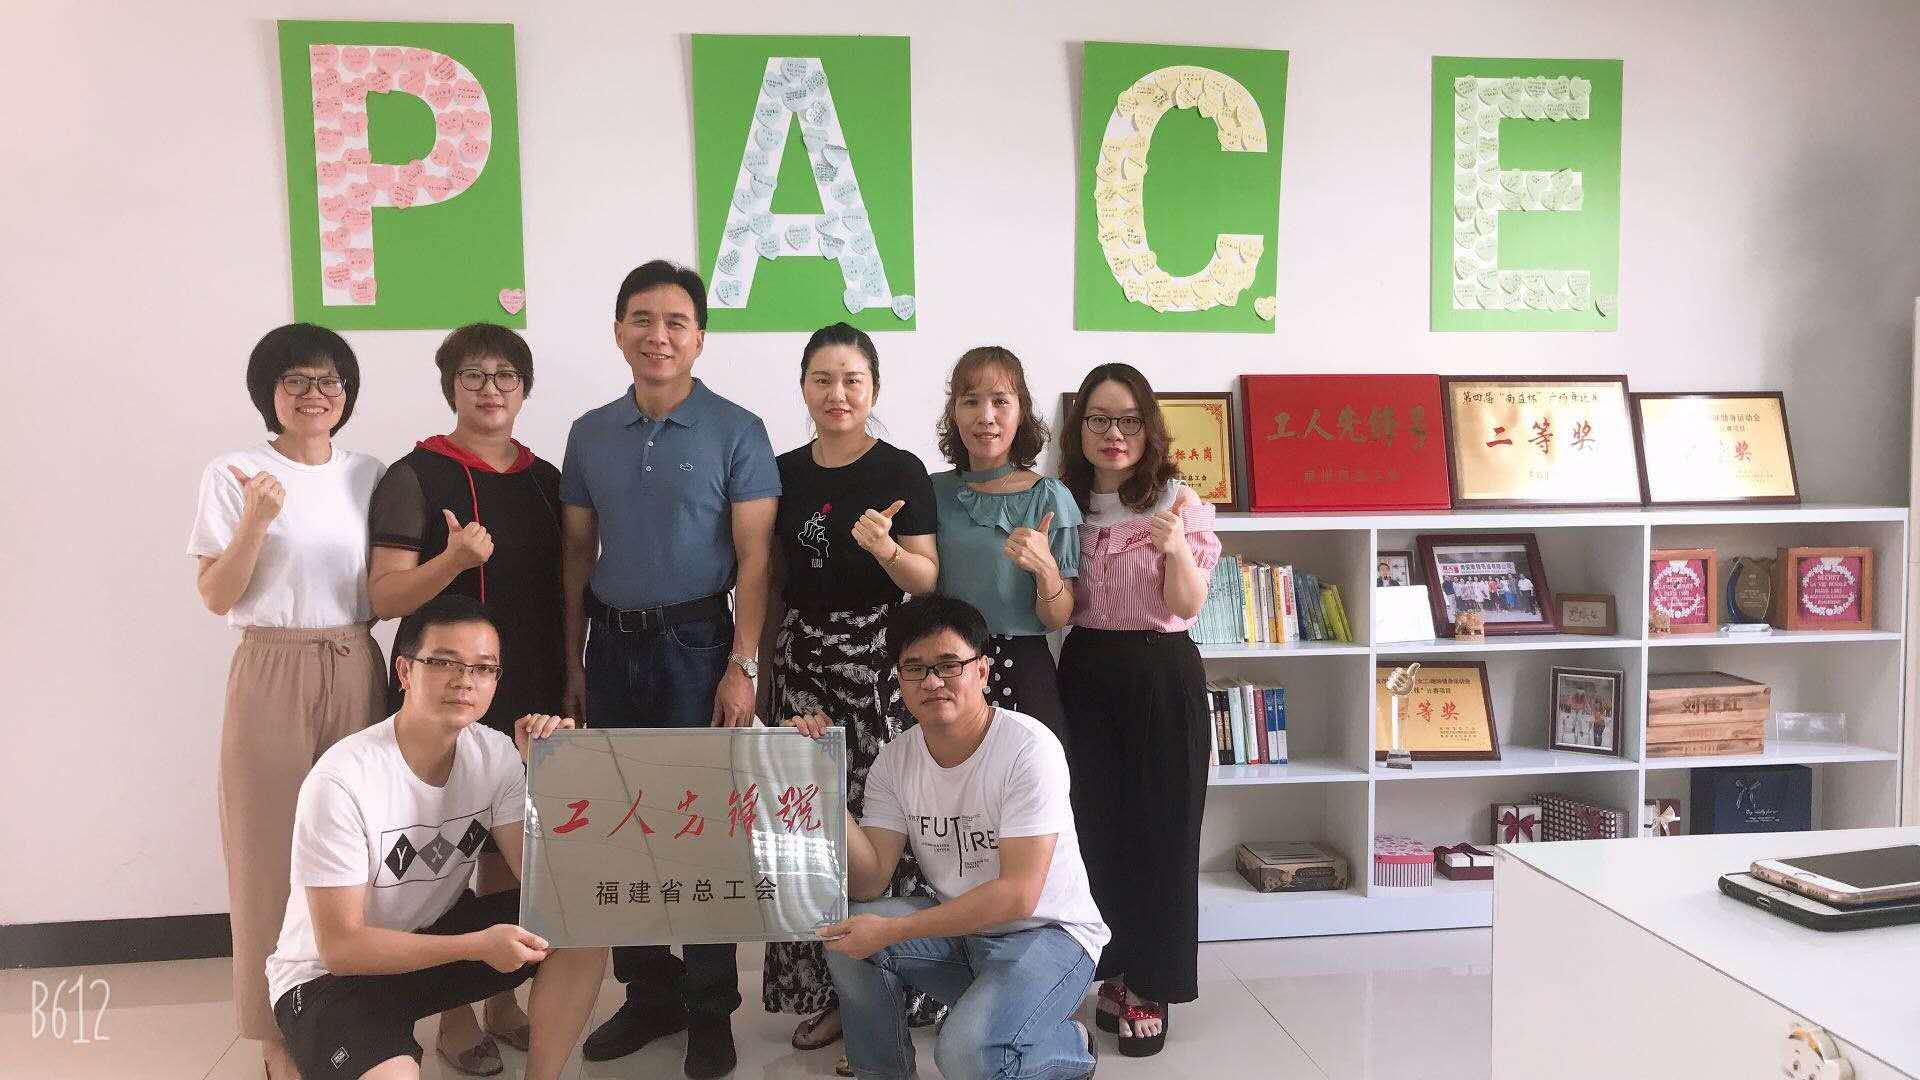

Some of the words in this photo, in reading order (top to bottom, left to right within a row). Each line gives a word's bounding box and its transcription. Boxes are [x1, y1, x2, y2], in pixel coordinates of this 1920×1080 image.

[1486, 417, 1597, 454] 二等奖
[596, 876, 777, 906] 福建省总工会
